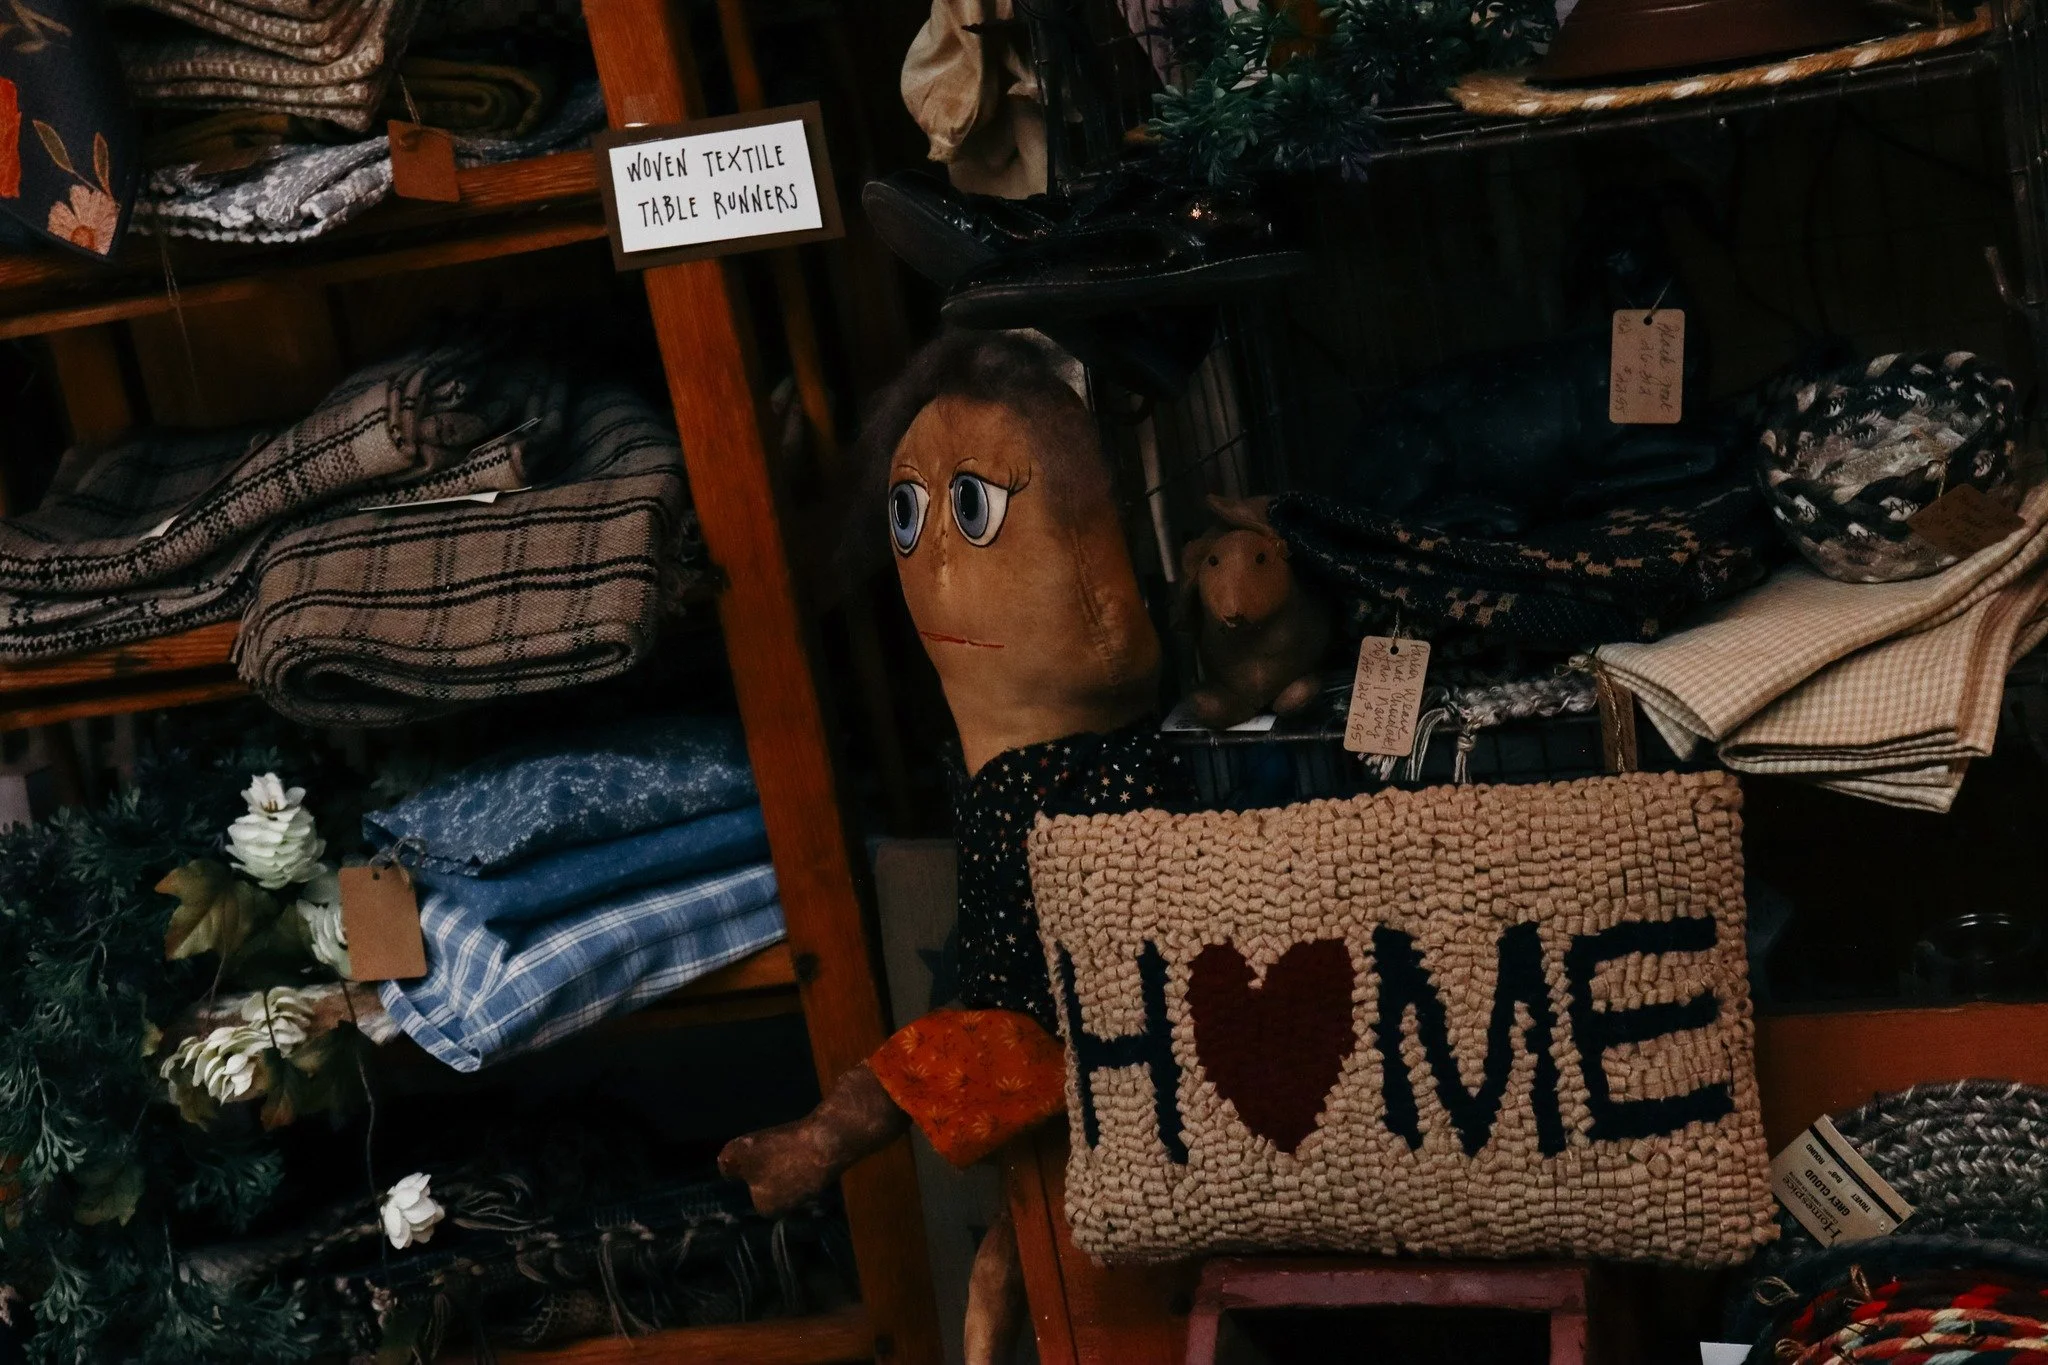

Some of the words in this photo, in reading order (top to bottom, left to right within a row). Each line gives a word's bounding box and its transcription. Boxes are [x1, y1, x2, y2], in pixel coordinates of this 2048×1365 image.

[626, 148, 688, 182] WOVEN
[702, 144, 785, 177] TEXTILE
[638, 195, 699, 227] TABLE
[713, 183, 798, 220] RUNNERS
[1805, 1143, 1825, 1165] ROUND
[1805, 1169, 1831, 1196] CLOUD
[1782, 1177, 1843, 1239] Homespice
[1830, 1196, 1850, 1216] GREY
[1850, 1193, 1871, 1213] TRIVET
